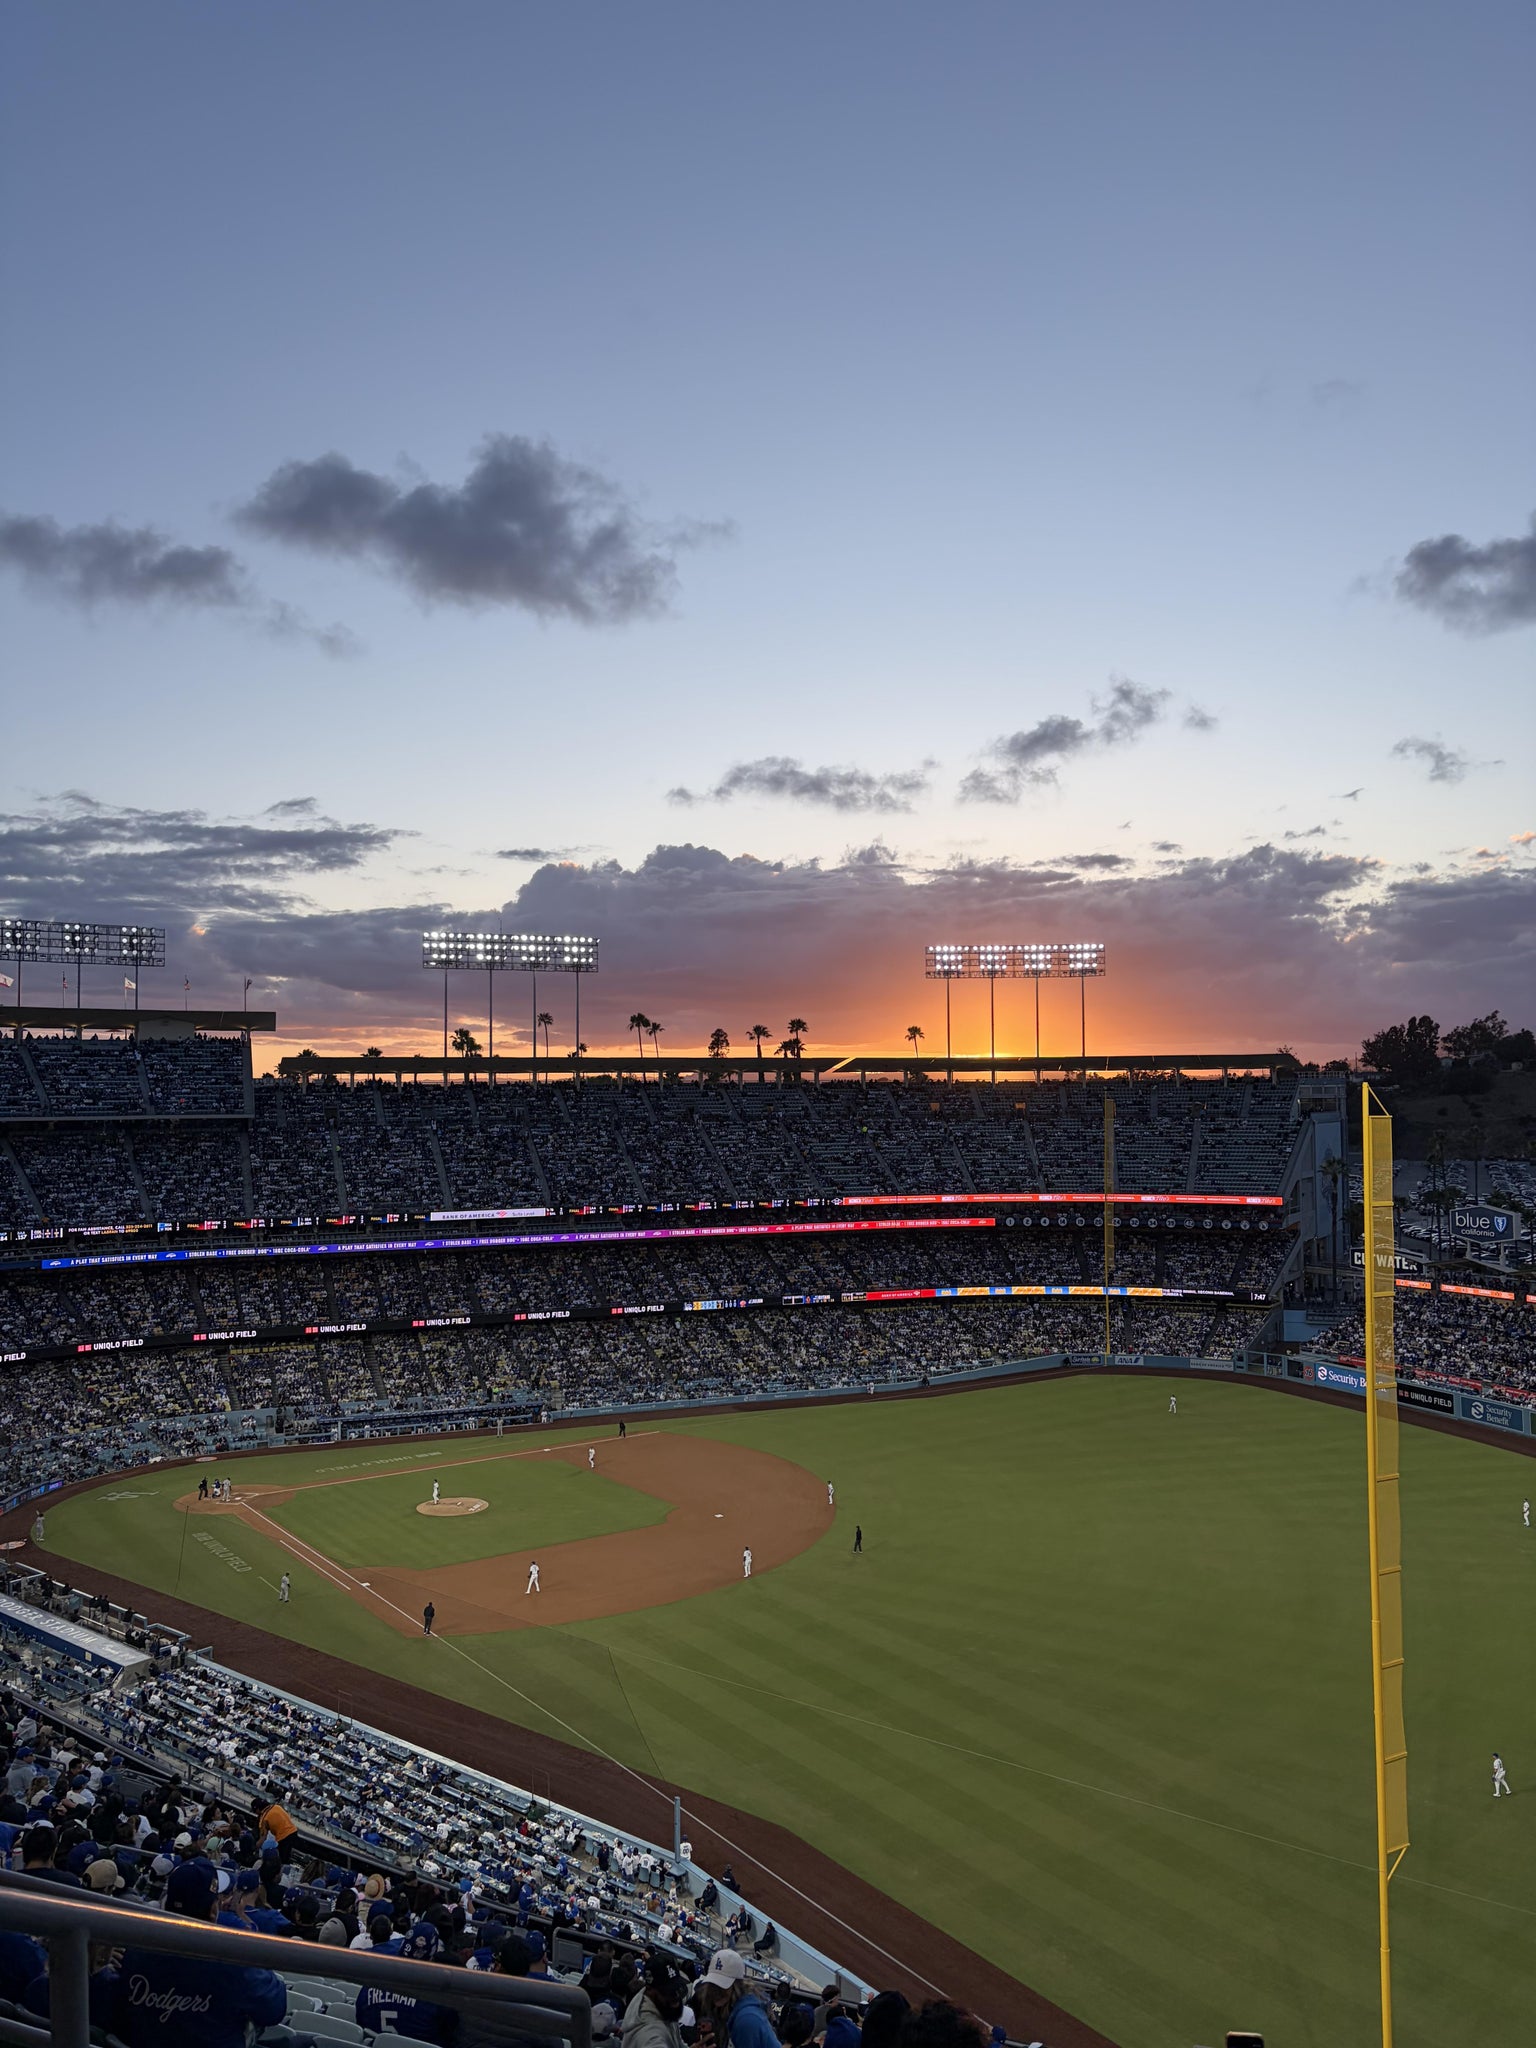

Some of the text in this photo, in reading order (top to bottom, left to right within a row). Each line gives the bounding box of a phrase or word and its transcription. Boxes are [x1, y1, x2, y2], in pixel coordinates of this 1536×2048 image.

[1455, 1211, 1490, 1229] blue
[1461, 1228, 1495, 1237] california
[1353, 1252, 1418, 1271] CWATER
[527, 1311, 550, 1320] UNIQLO
[624, 1306, 646, 1314] UNIQLO
[320, 1324, 345, 1333] UNIQLO
[426, 1317, 471, 1327] UNIQLO FIELD
[208, 1330, 257, 1340] UNIQLO FIELD
[93, 1339, 144, 1351] UNIQLO FIELD
[4, 1352, 26, 1362] FIELD
[1304, 1368, 1314, 1377] 76
[1328, 1371, 1359, 1387] Security
[1410, 1391, 1452, 1408] UNIQLO FIELD
[1486, 1404, 1512, 1418] Security
[1486, 1412, 1510, 1426] Benefit
[40, 1618, 98, 1644] STADIUM
[715, 1957, 723, 1970] LA
[666, 1964, 676, 1979] LA
[128, 1974, 212, 2023] Dodgers
[367, 1987, 417, 2008] FREEMAN
[380, 2010, 398, 2035] 5
